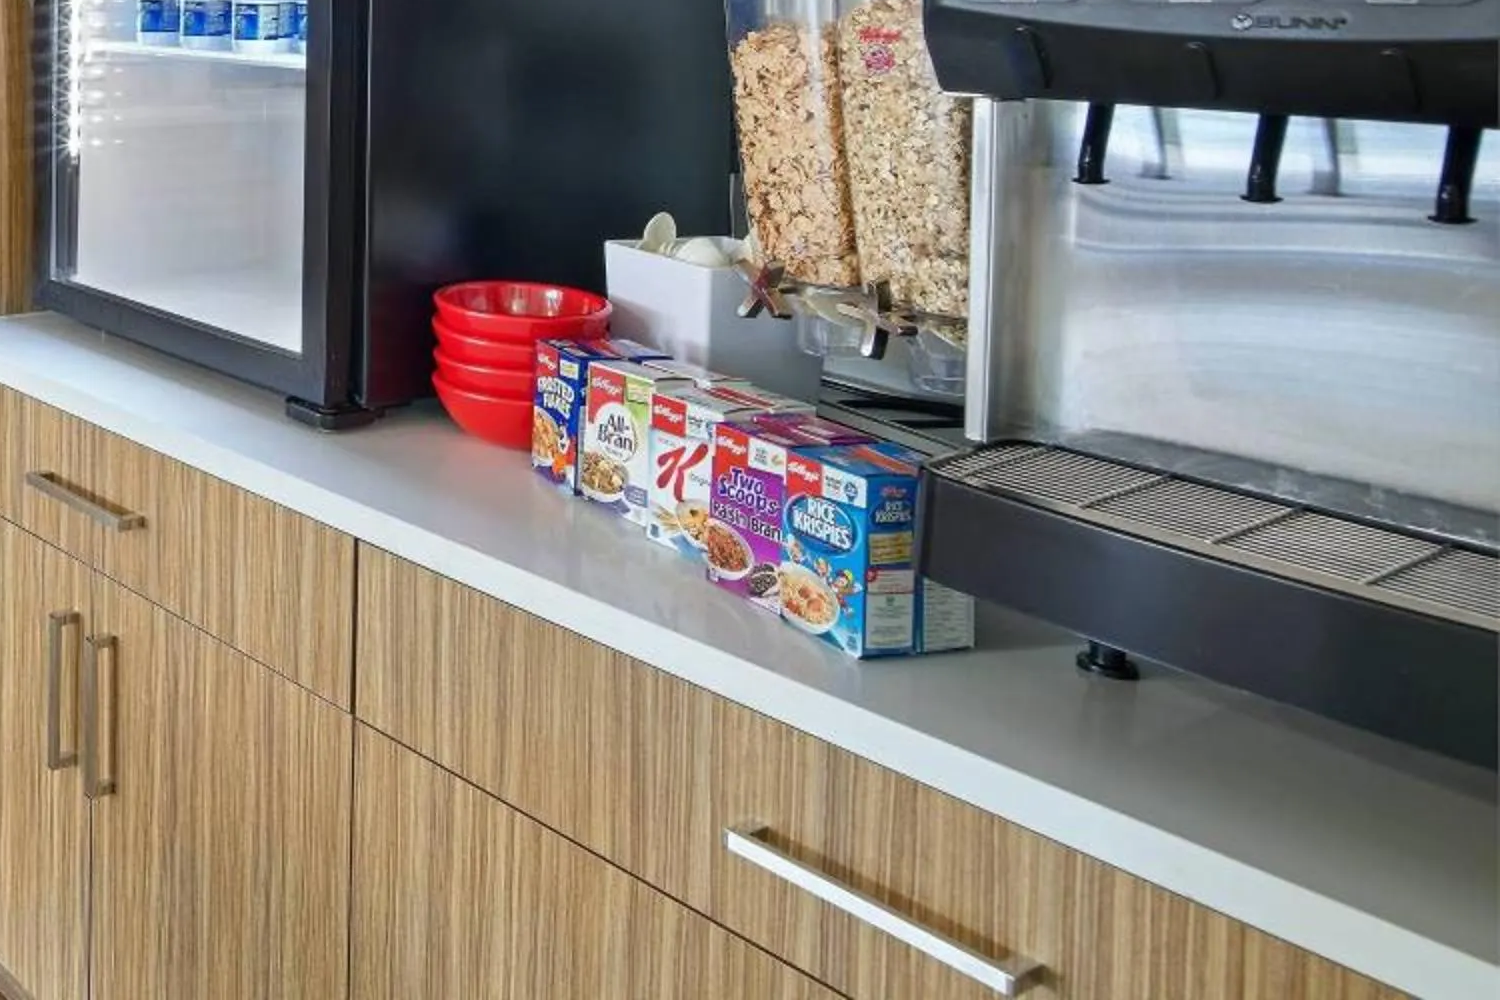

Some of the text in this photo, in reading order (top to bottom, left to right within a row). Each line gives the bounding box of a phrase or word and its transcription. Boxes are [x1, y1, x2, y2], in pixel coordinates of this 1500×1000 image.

[598, 423, 633, 452] Bran
[656, 443, 708, 503] K
[731, 467, 764, 495] Two
[719, 475, 778, 515] Scoops
[807, 496, 837, 525] RICE
[750, 516, 783, 543] Bran
[792, 506, 853, 550] KRISPIES
